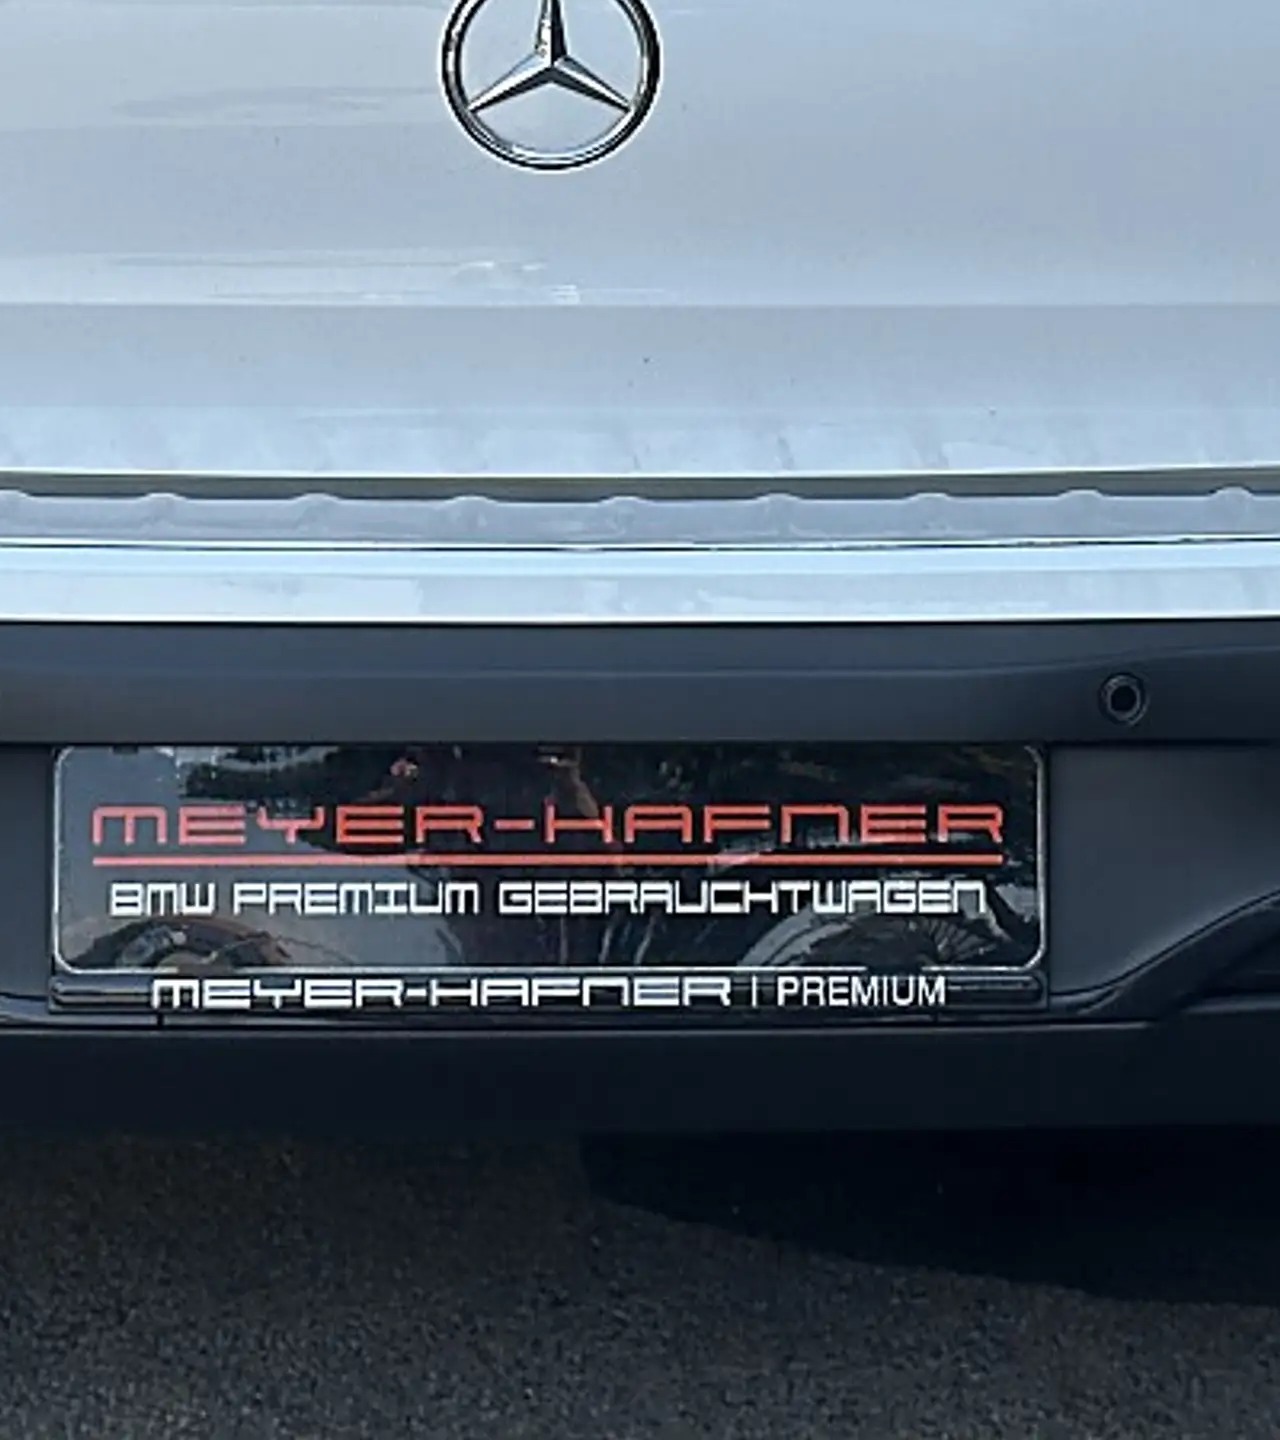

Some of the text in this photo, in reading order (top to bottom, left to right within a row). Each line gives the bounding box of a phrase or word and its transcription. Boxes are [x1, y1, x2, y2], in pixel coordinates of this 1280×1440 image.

[91, 804, 1005, 845] MEYER-HAFNER
[109, 880, 988, 917] BMW PREMIUM GEBRAUCHTWAGEN
[151, 976, 948, 1009] MEYER-HAFNER PREMIUM
